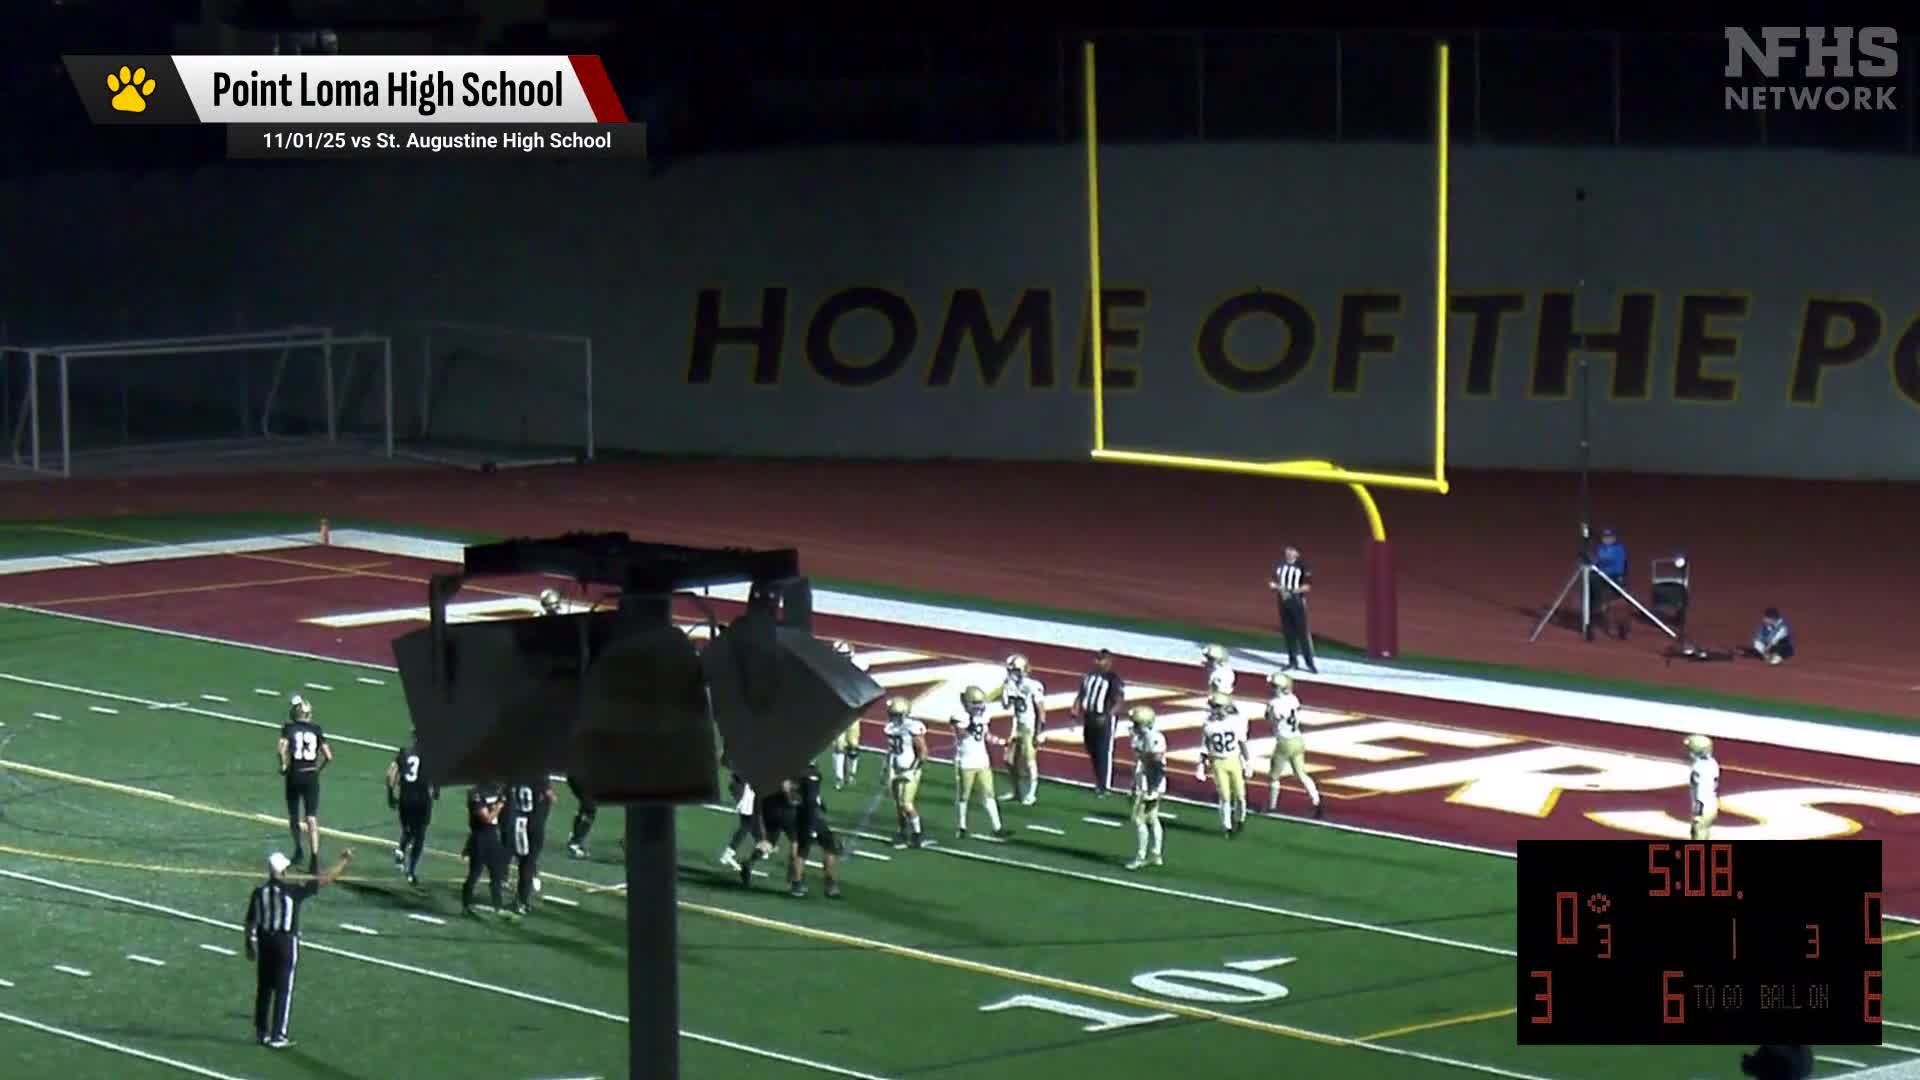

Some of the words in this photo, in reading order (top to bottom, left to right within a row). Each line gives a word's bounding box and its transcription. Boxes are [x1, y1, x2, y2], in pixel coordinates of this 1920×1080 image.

[685, 286, 1148, 391] HOME
[1197, 289, 1403, 398] OF
[1447, 289, 1751, 401] THE
[1789, 295, 1920, 406] P
[293, 730, 318, 761] 13
[1211, 731, 1236, 753] 82
[979, 968, 1290, 1032] 10
